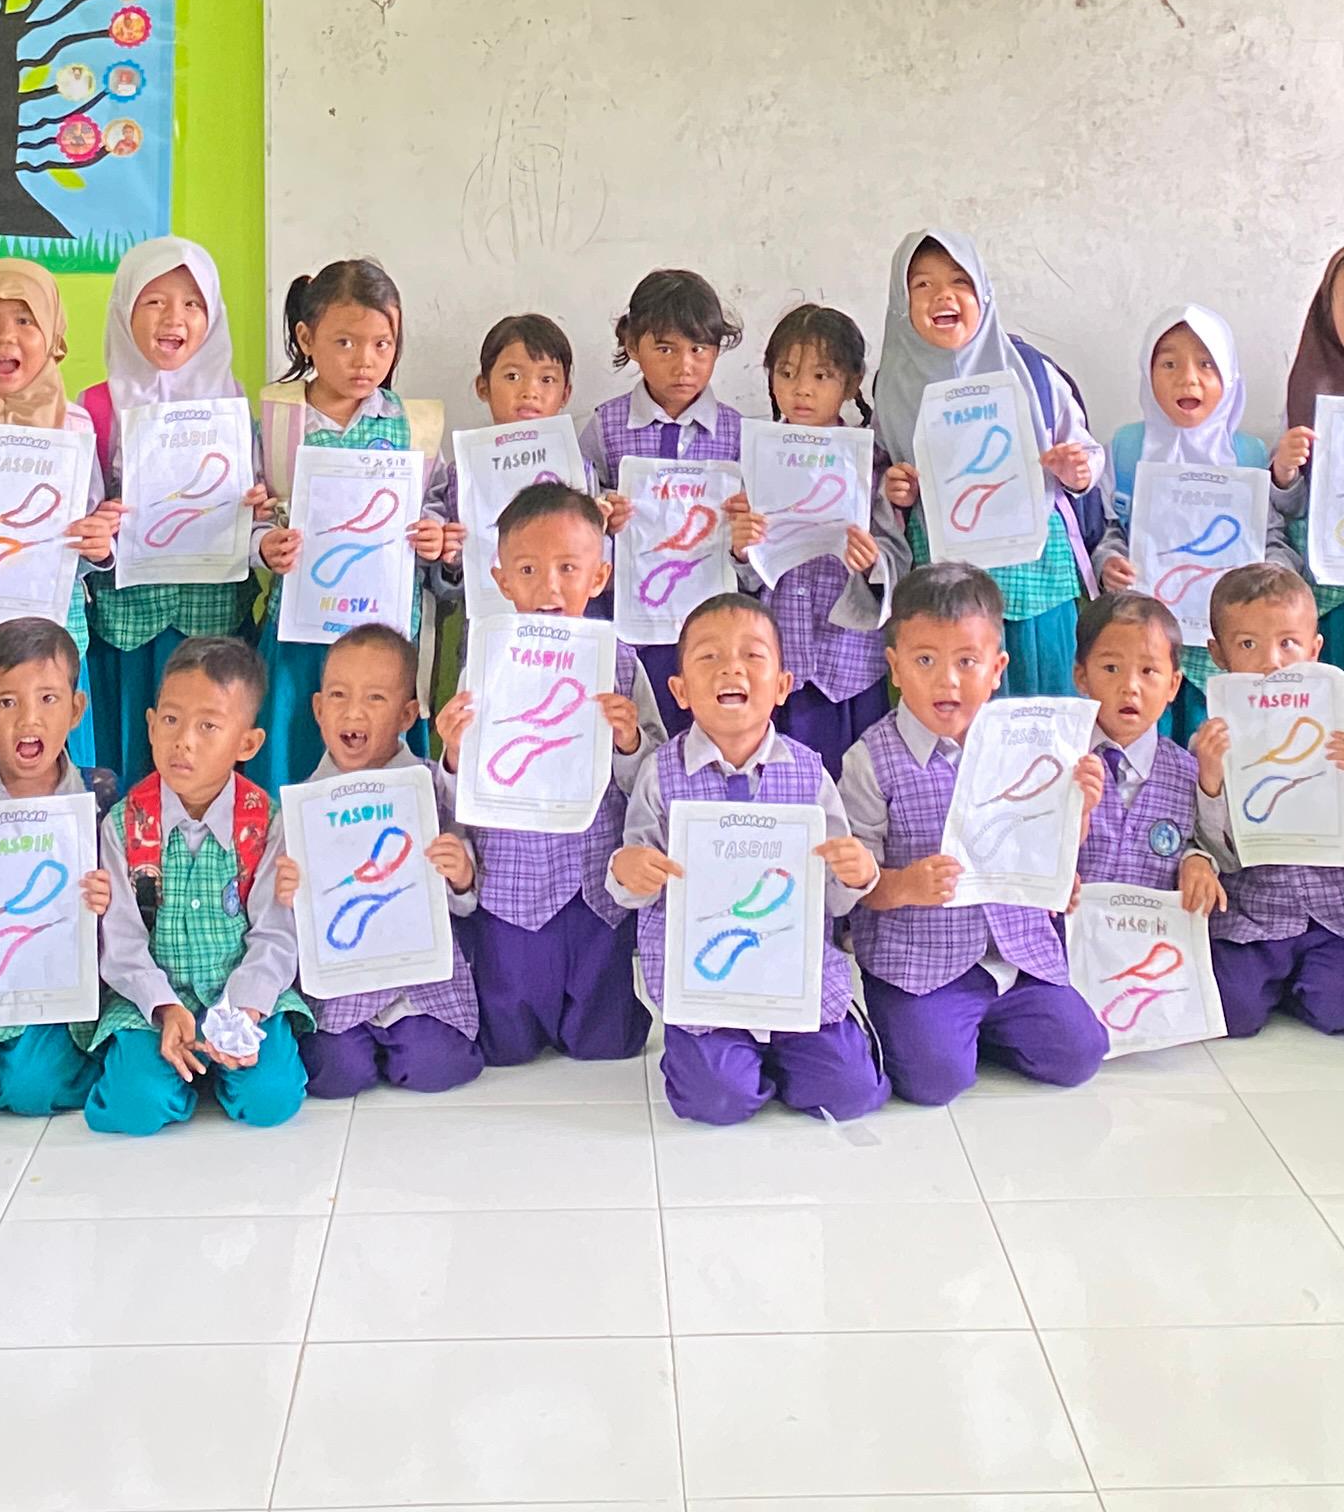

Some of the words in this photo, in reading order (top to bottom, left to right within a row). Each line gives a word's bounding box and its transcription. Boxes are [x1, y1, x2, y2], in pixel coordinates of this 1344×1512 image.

[492, 448, 546, 471] TASBIH
[517, 626, 570, 640] MEWARNAI
[1248, 693, 1310, 708] TASBIH
[331, 783, 385, 800] MEWARNAI
[720, 815, 776, 829] MEWARNAI
[713, 840, 782, 858] TASBIH
[1105, 915, 1167, 935] TASBIH
